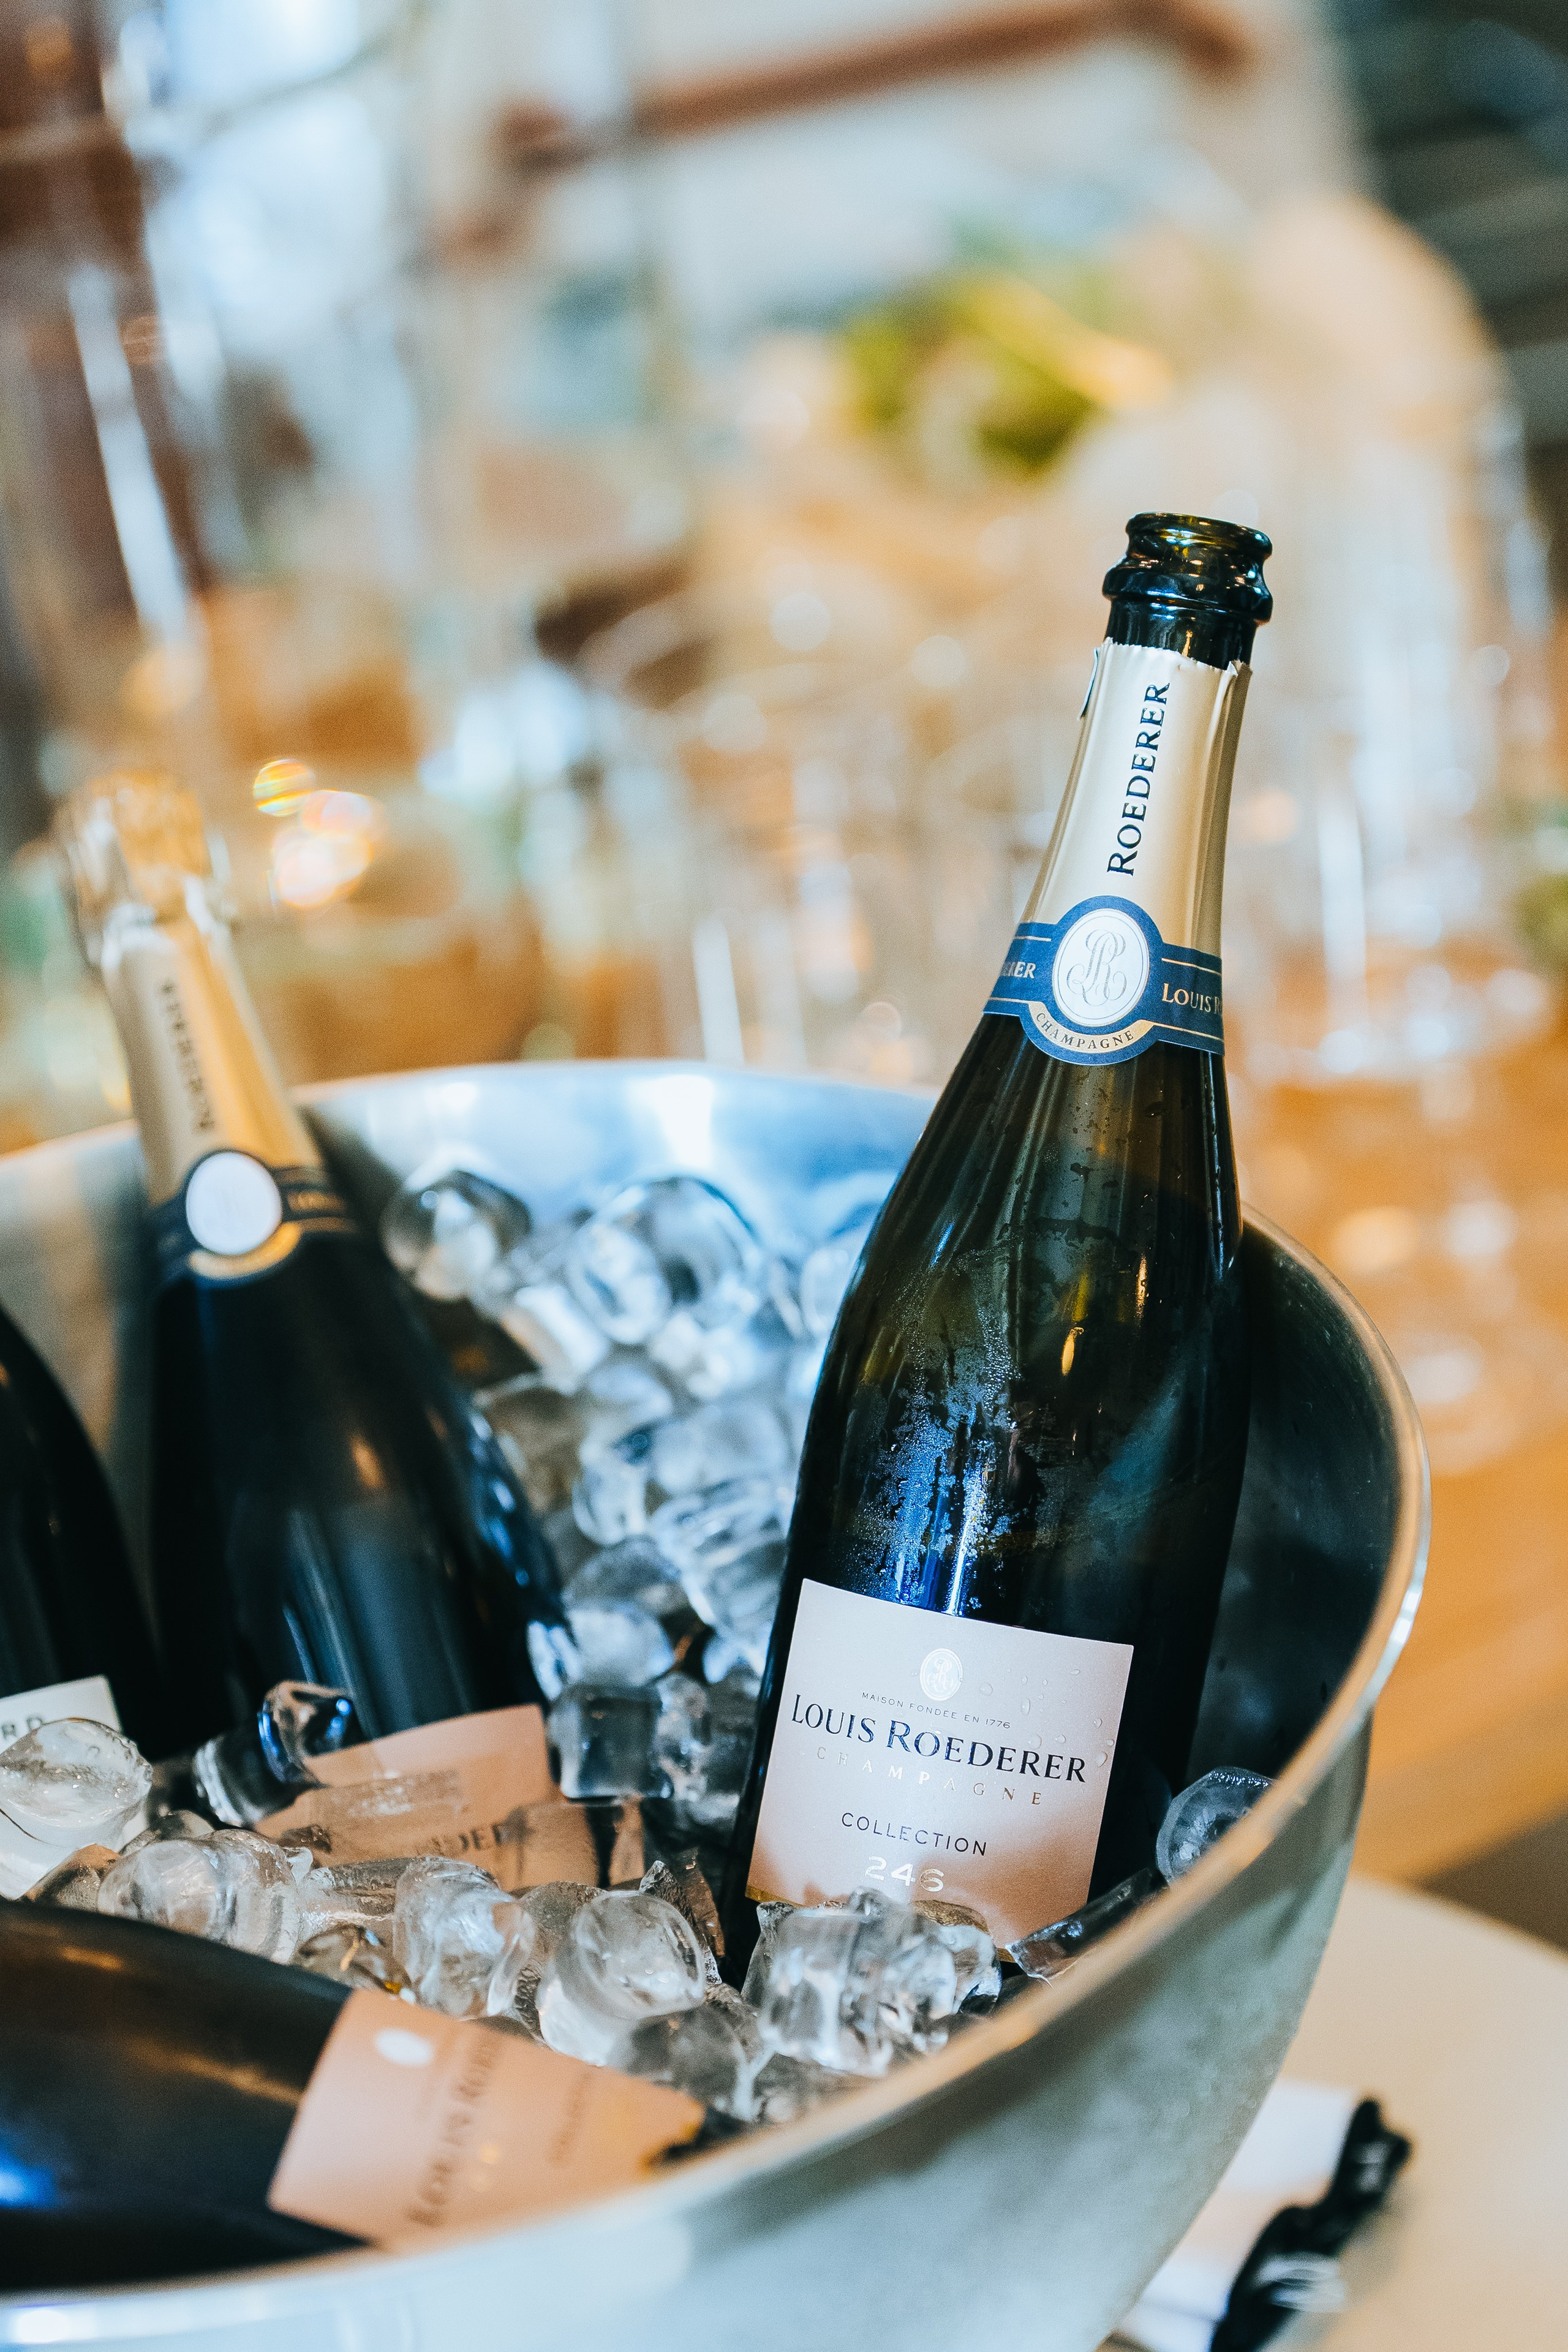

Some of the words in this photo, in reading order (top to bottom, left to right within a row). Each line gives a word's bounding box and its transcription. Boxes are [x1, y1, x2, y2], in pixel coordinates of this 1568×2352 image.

[1106, 682, 1170, 876] ROEDERER
[1161, 982, 1212, 1013] LOUIS
[1036, 1012, 1134, 1049] CHAMPAGNE
[862, 1692, 904, 1708] MAISON
[909, 1703, 958, 1719] FONDÉE
[964, 1714, 980, 1723] EN
[986, 1718, 1011, 1729] 1776
[791, 1694, 876, 1743] LOUIS
[886, 1719, 1086, 1783] ROEDERER
[816, 1746, 1042, 1805] CHAMPAGNE
[842, 1812, 987, 1856] COLLECTION
[864, 1856, 944, 1892] 246
